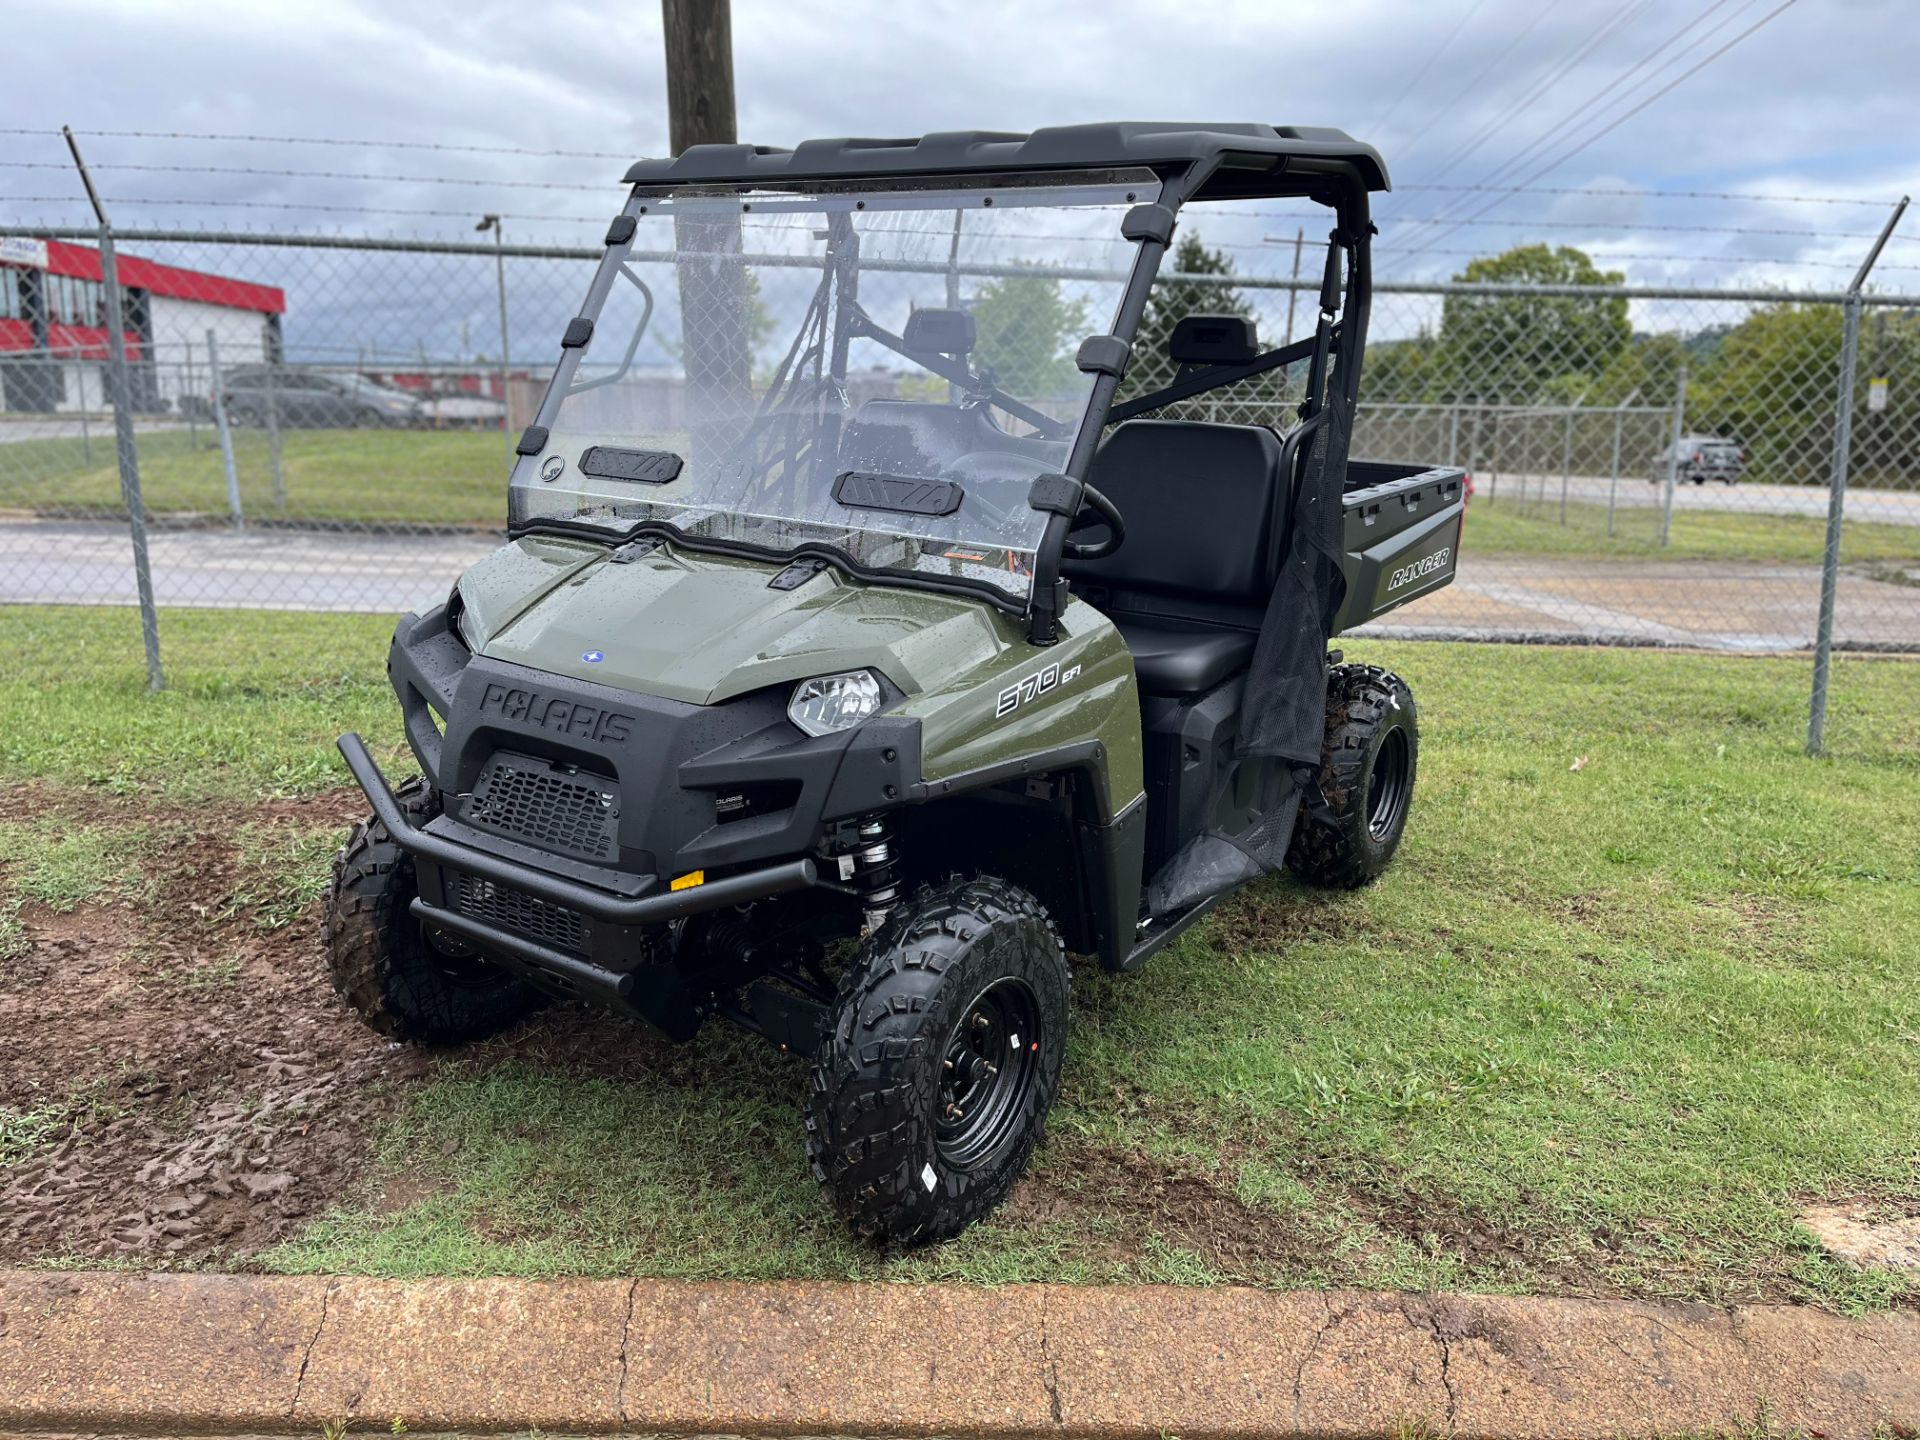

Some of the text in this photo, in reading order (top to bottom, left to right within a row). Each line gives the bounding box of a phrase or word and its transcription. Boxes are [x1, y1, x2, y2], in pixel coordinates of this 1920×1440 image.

[1387, 547, 1450, 591] RANGER
[479, 682, 636, 744] POLARIS
[995, 662, 1082, 719] 570 EFI
[715, 794, 743, 805] OLARIS
